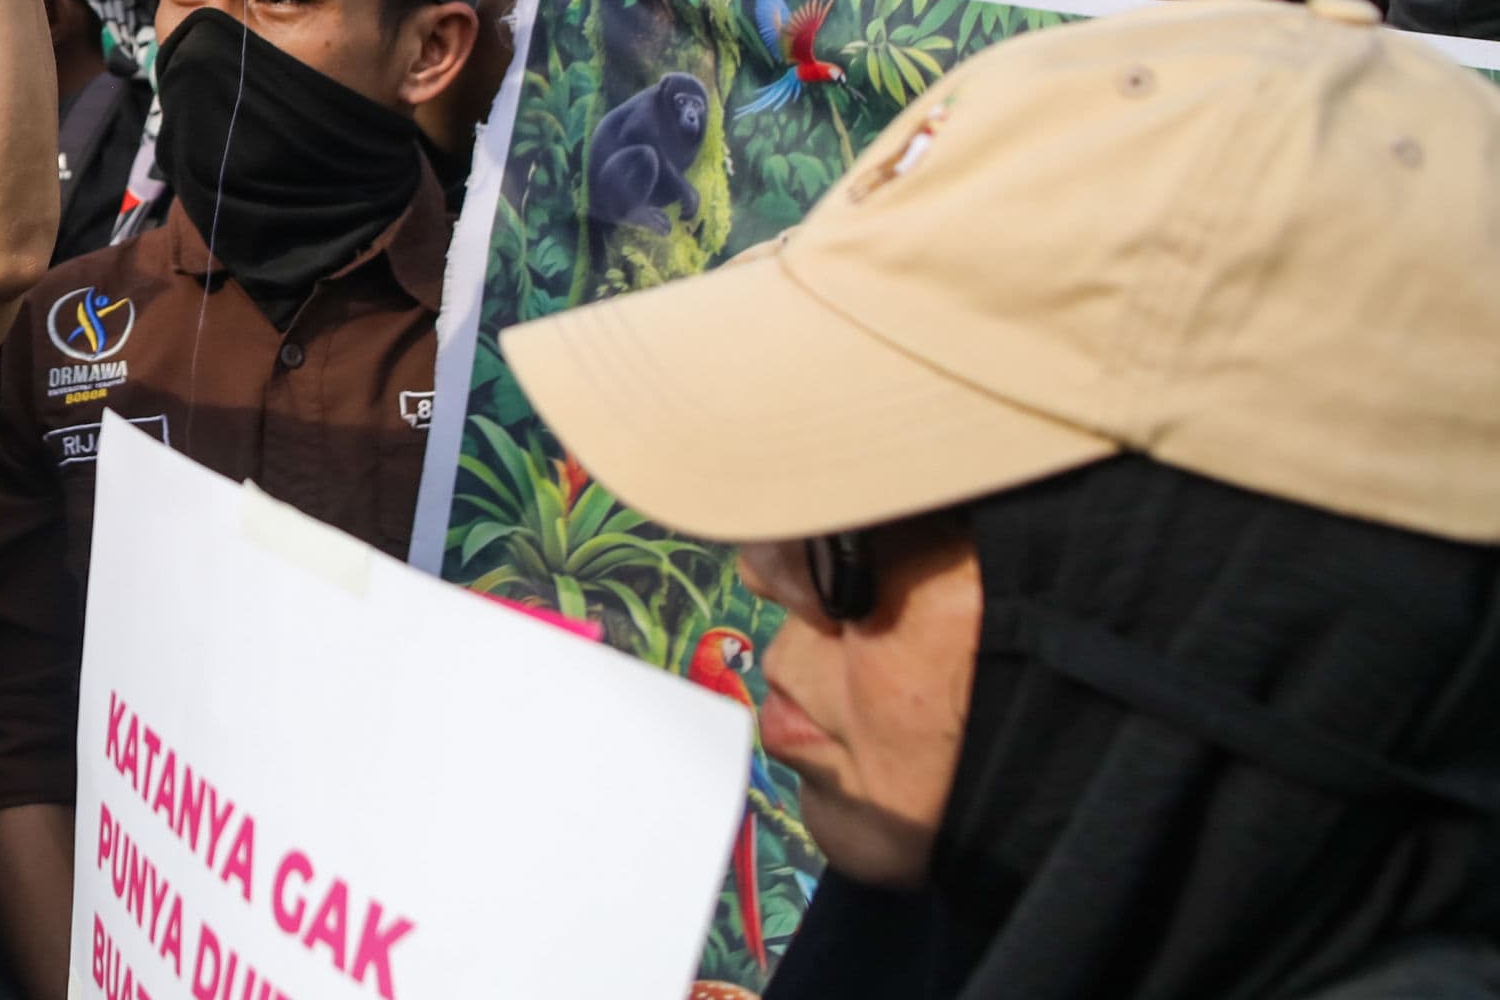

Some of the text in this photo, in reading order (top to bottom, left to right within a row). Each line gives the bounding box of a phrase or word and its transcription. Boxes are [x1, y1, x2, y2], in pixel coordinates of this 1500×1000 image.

[49, 360, 127, 387] ORMAWA
[62, 433, 100, 456] RIJ
[98, 800, 183, 980] PUNYA
[106, 690, 417, 1000] KATANYA GAK
